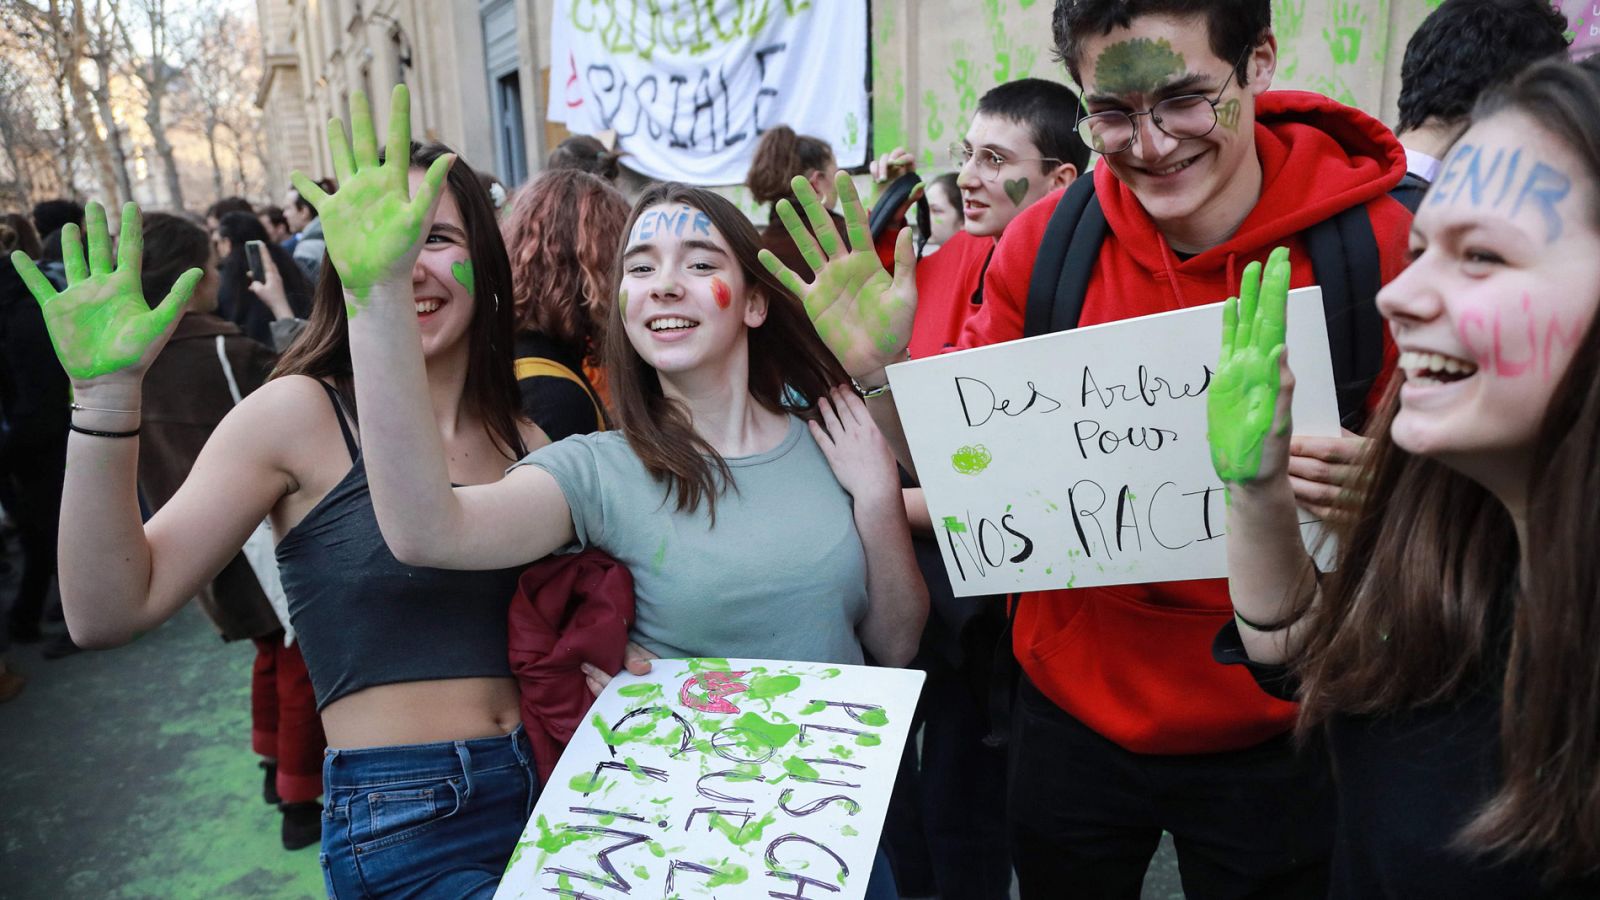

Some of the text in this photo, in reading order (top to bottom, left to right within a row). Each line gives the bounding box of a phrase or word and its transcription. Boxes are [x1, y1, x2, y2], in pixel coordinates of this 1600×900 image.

[955, 376, 1061, 427] Des
[1074, 419, 1178, 460] Pour
[945, 479, 1226, 582] NOS RACI
[684, 726, 778, 837] QUE
[777, 699, 889, 816] PLUS
